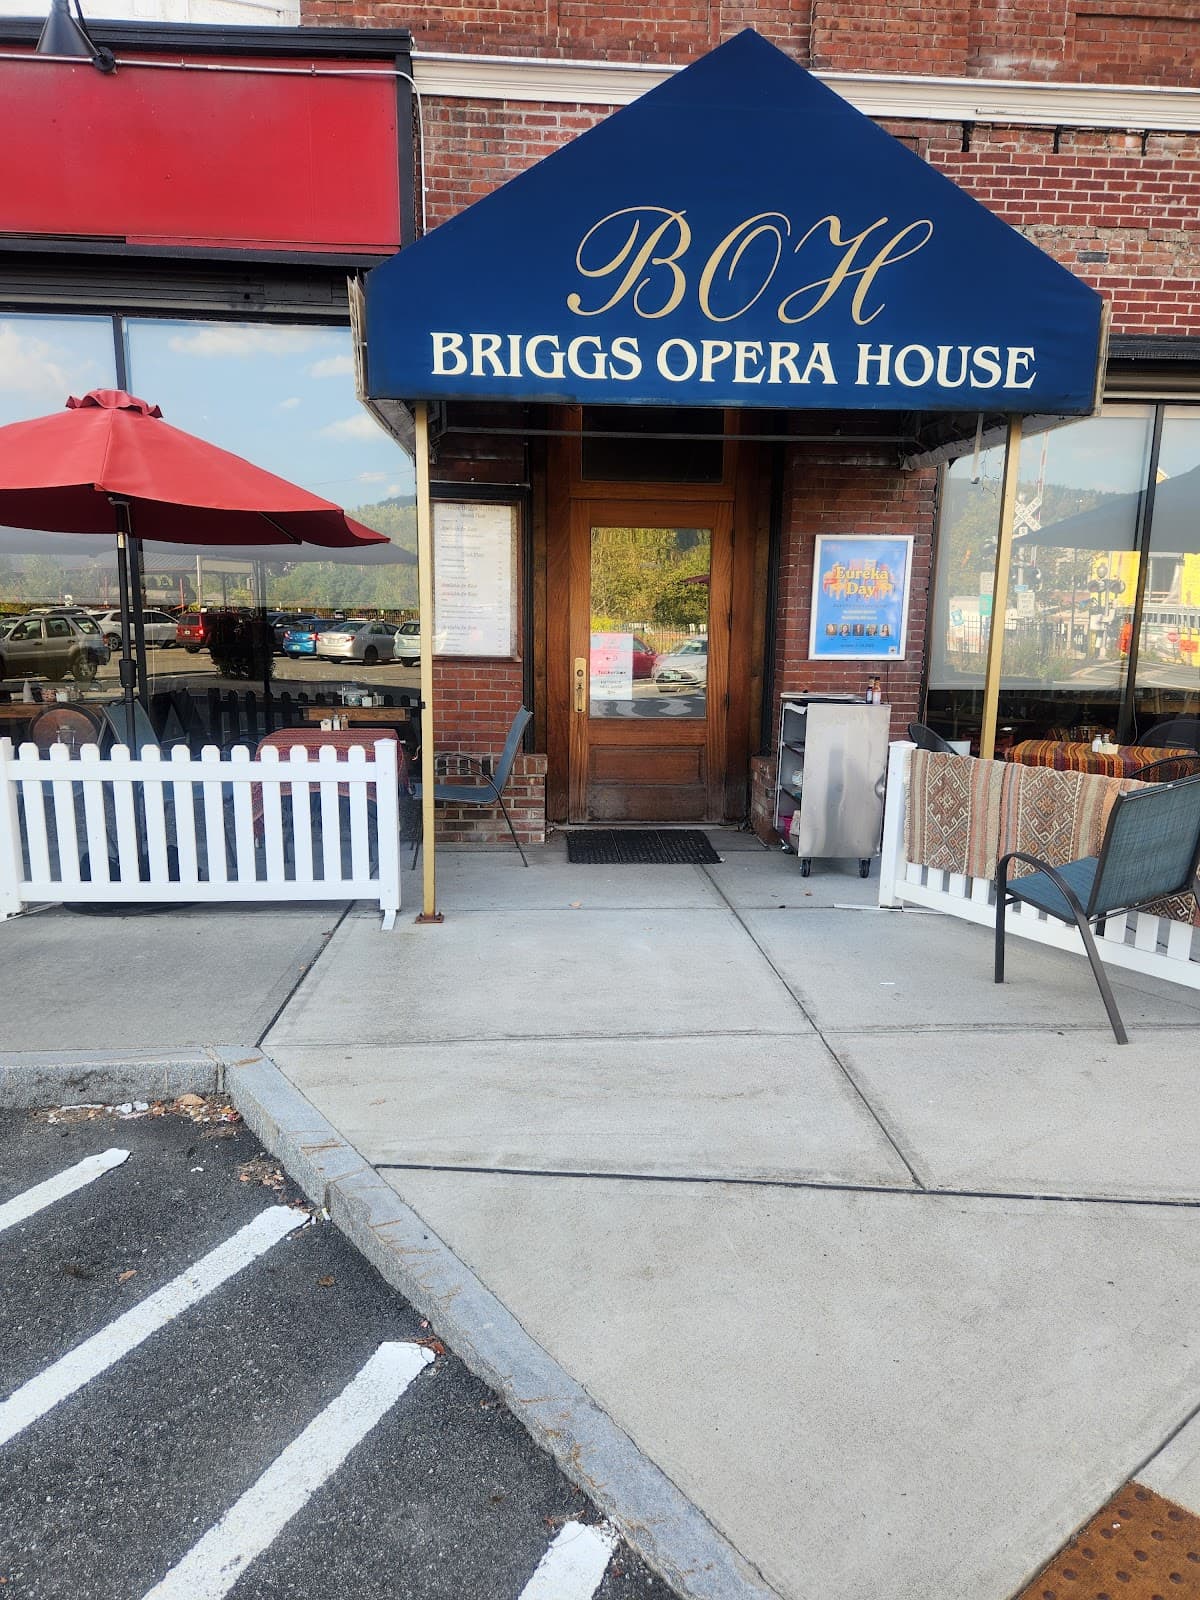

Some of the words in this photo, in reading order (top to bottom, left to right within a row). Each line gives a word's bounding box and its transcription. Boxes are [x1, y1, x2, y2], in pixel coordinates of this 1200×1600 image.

[567, 207, 933, 326] BOH
[430, 332, 643, 381] BRIGGS
[656, 338, 838, 386] OPERA
[855, 343, 1037, 390] HOUSE
[835, 565, 889, 580] Eureka
[846, 582, 875, 598] Day
